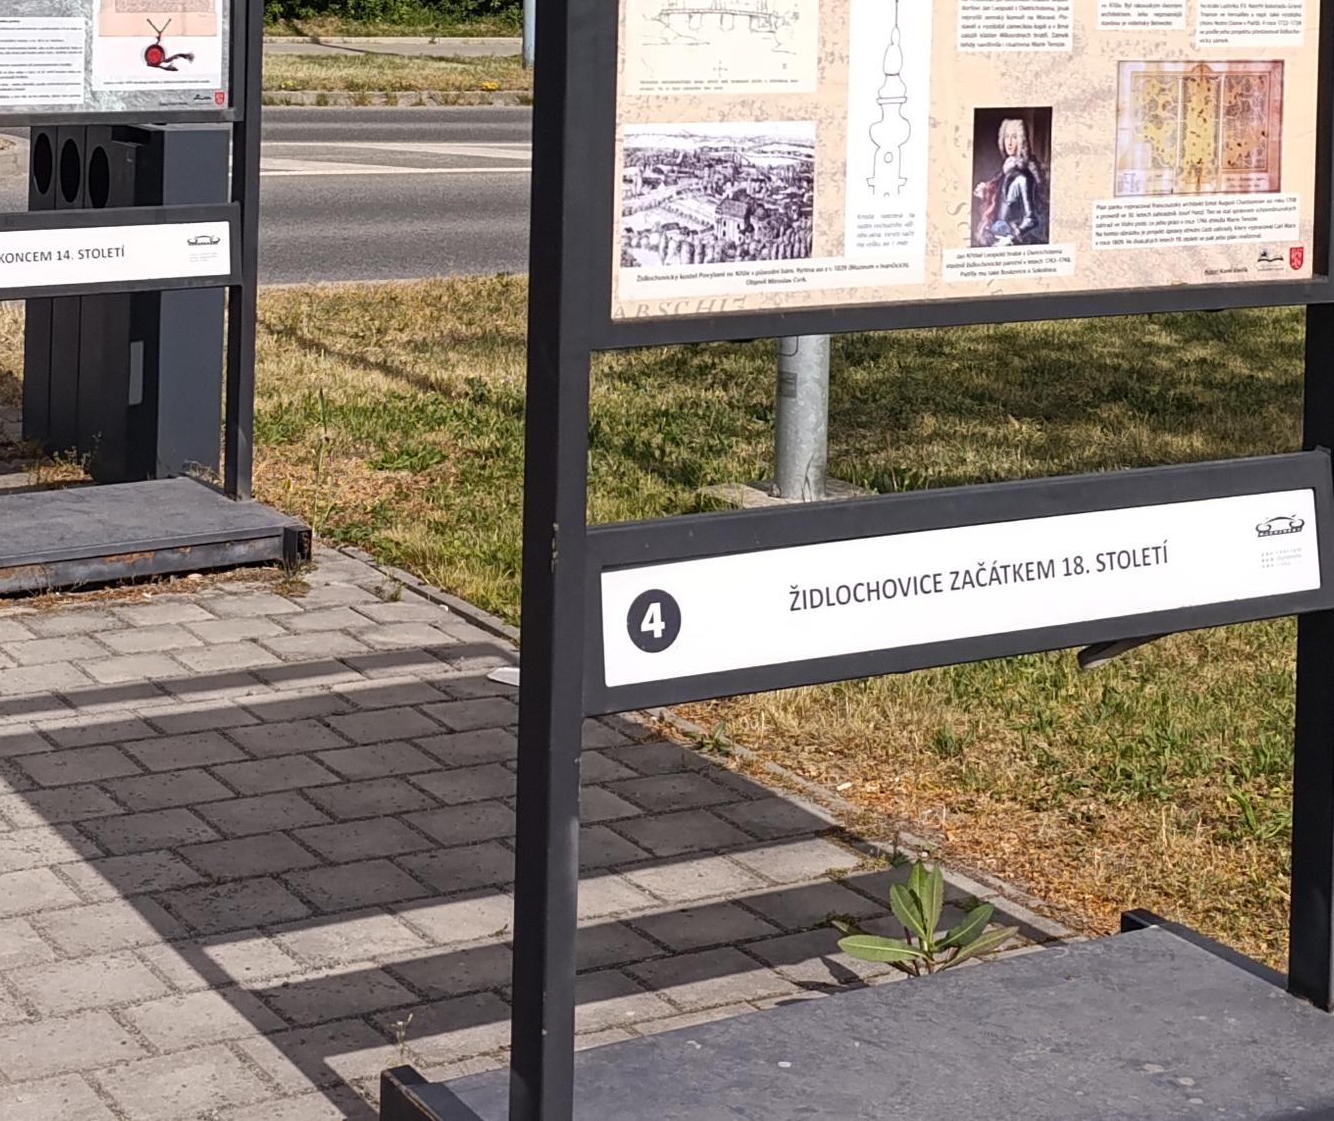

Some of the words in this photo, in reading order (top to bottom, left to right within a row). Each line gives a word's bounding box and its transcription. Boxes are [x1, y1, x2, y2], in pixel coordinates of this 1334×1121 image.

[57, 250, 74, 261] 14.
[78, 244, 125, 260] STOLETÍ
[789, 572, 944, 612] ŽIDLOCHOVICE
[949, 558, 1056, 591] ZAČÁTKEM
[1062, 555, 1090, 577] 18.
[1095, 539, 1168, 573] STOLETÍ
[641, 602, 666, 638] 4
